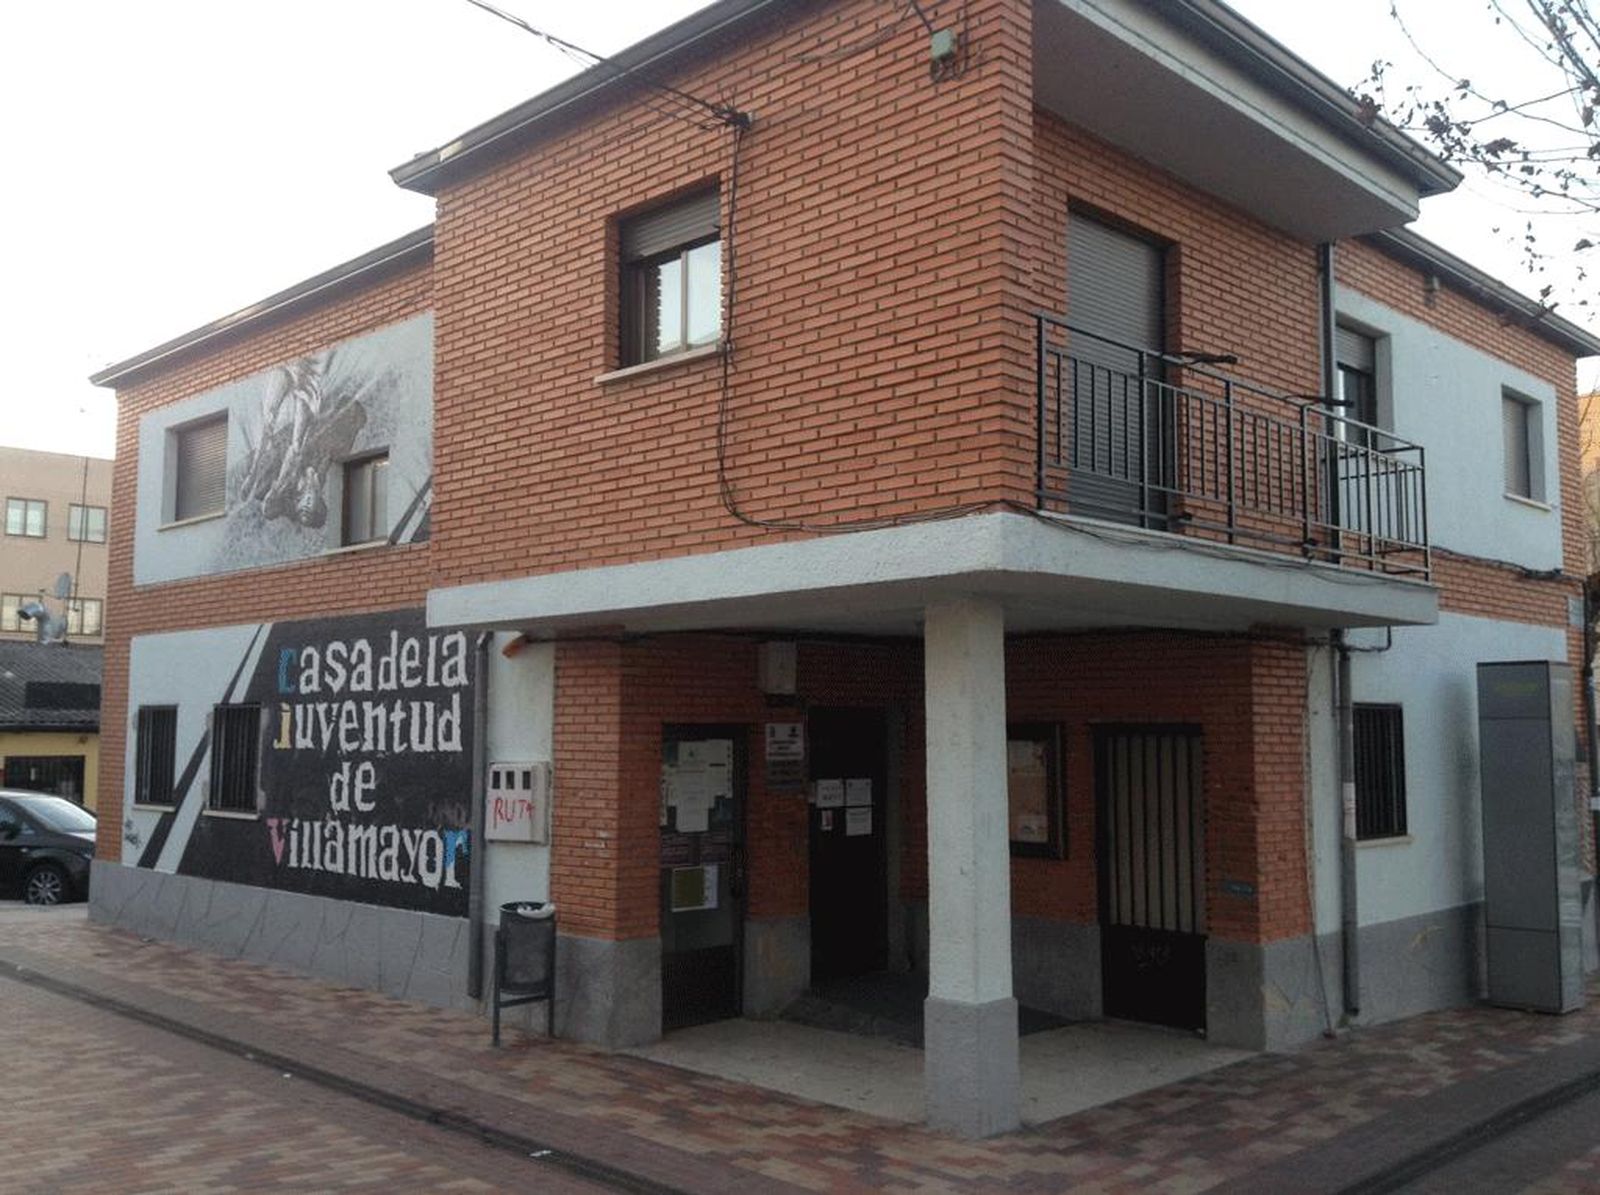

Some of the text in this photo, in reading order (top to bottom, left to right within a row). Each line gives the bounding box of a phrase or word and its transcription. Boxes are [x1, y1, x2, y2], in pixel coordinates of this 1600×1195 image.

[273, 692, 463, 753] juventud
[330, 761, 376, 813] de
[266, 818, 470, 890] Villamayor
